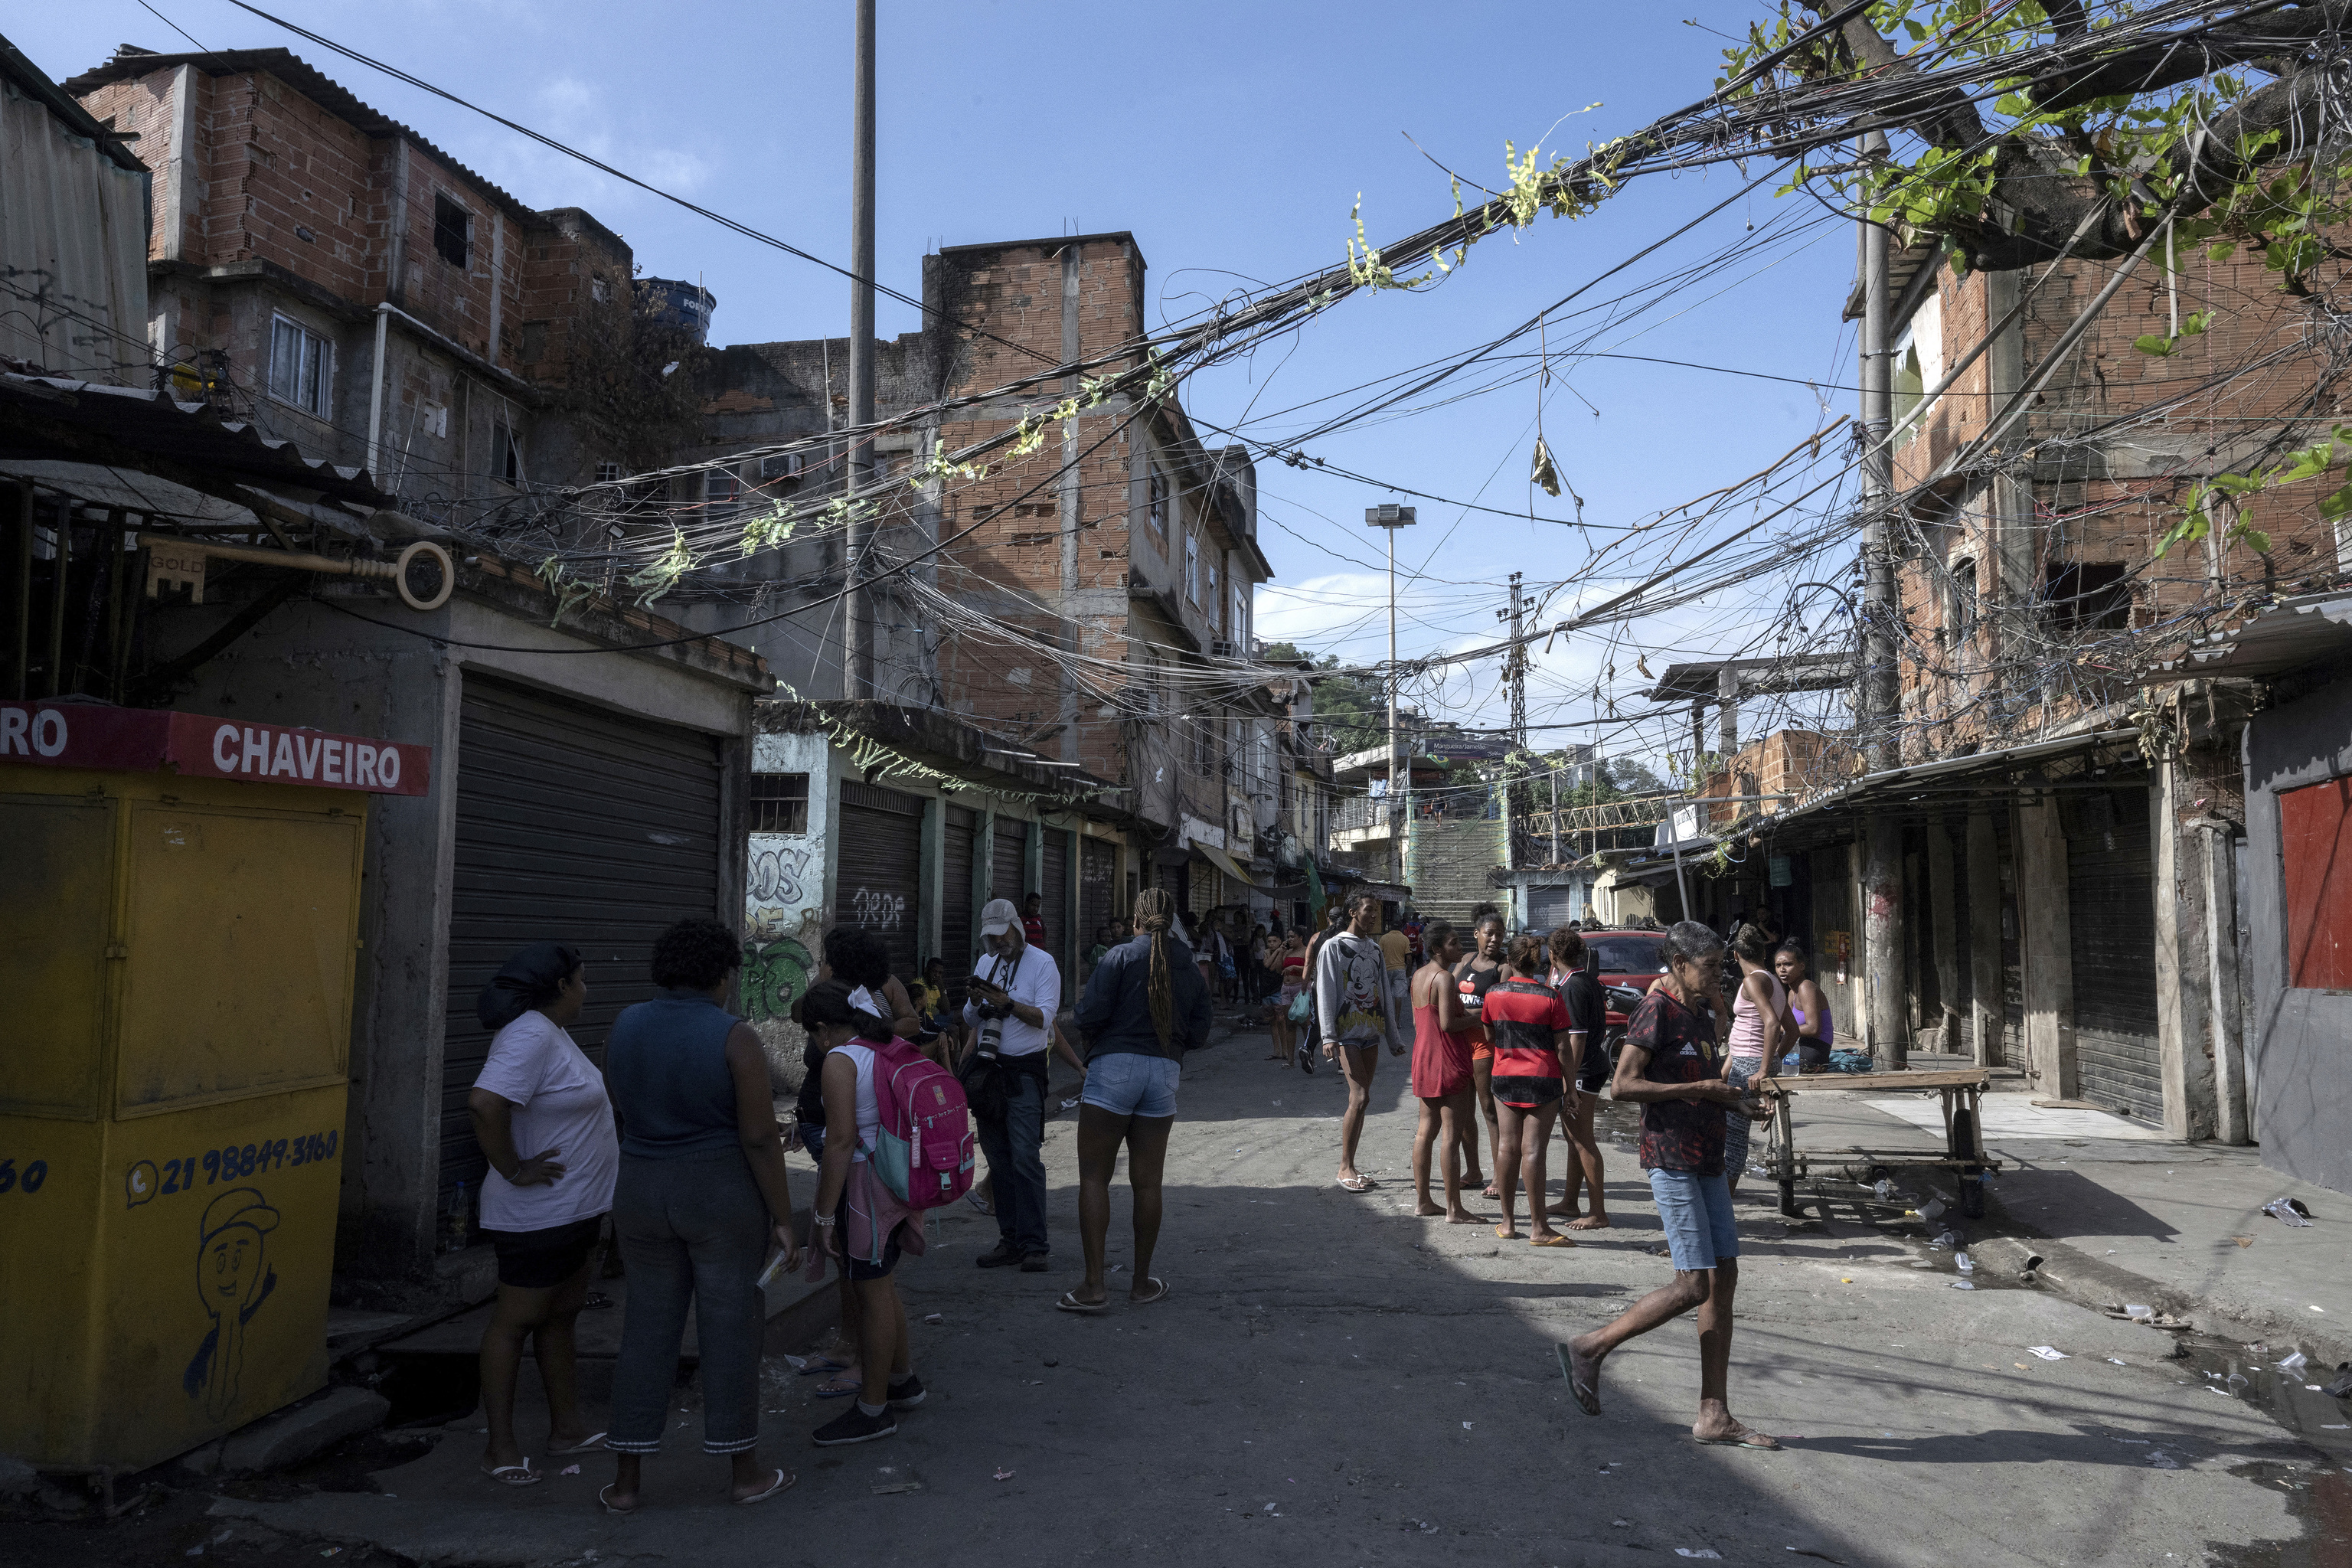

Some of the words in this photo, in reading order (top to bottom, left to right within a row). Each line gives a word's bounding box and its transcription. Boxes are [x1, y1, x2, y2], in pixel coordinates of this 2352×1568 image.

[151, 556, 204, 573] GOLD
[0, 707, 68, 757] RO
[212, 724, 401, 789] CHAVEIRO
[1338, 1009, 1386, 1036] MINNIE
[0, 1158, 48, 1194] 60
[161, 1157, 194, 1195] 21
